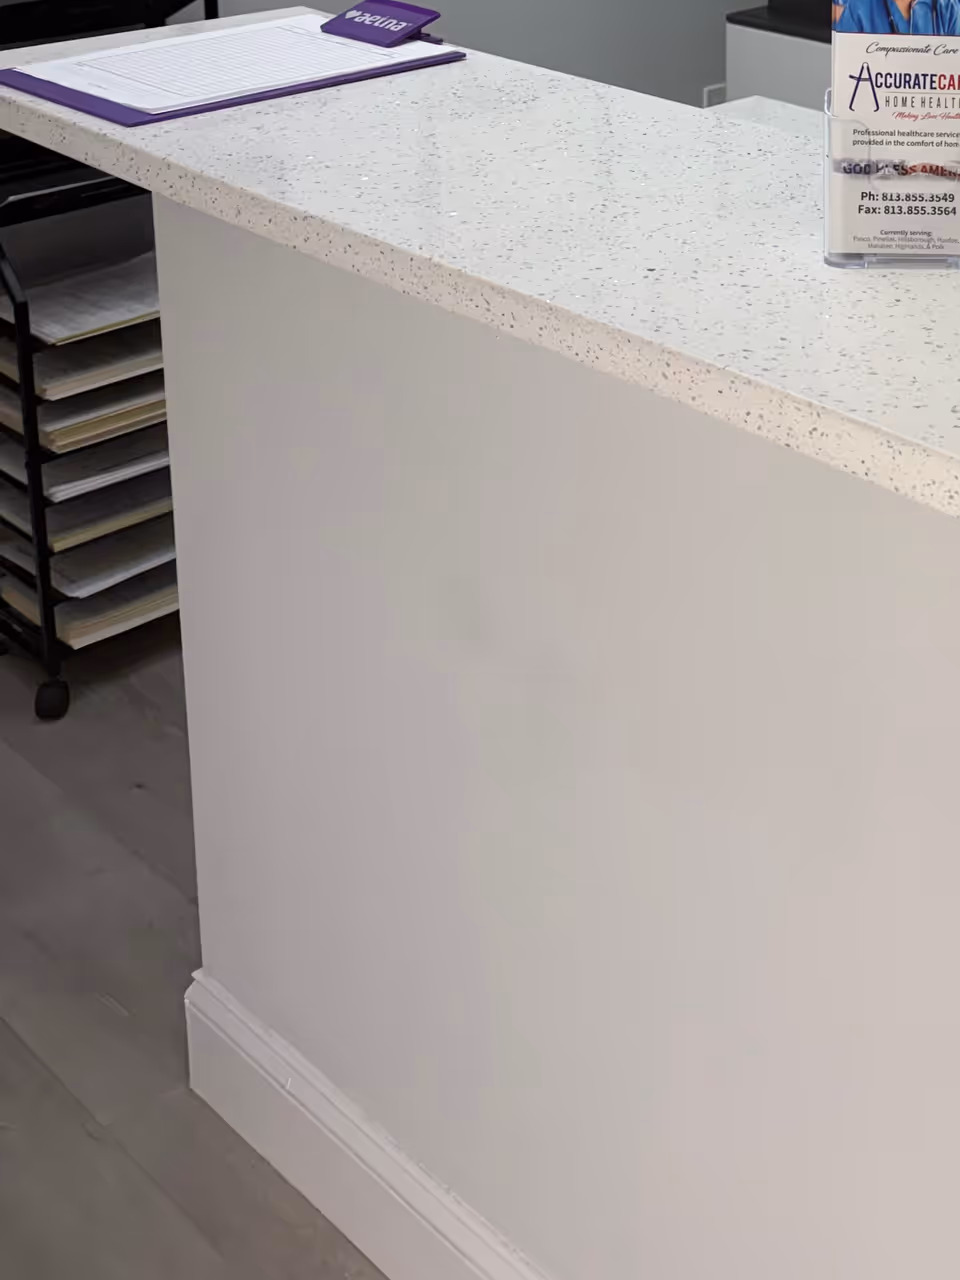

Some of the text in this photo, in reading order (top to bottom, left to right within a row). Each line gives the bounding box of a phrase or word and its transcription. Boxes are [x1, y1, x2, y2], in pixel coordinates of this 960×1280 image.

[354, 12, 407, 31] aetna
[866, 42, 959, 59] Compassionate Care
[885, 96, 915, 108] HOME
[852, 128, 896, 137] Professional
[897, 129, 935, 137] healthcare
[852, 138, 884, 146] provided
[885, 138, 892, 146] in
[893, 138, 905, 146] the
[906, 139, 934, 147] comfort
[861, 191, 955, 203] Ph: 813.855.3549
[858, 205, 957, 216] Fax: 813.855.3564
